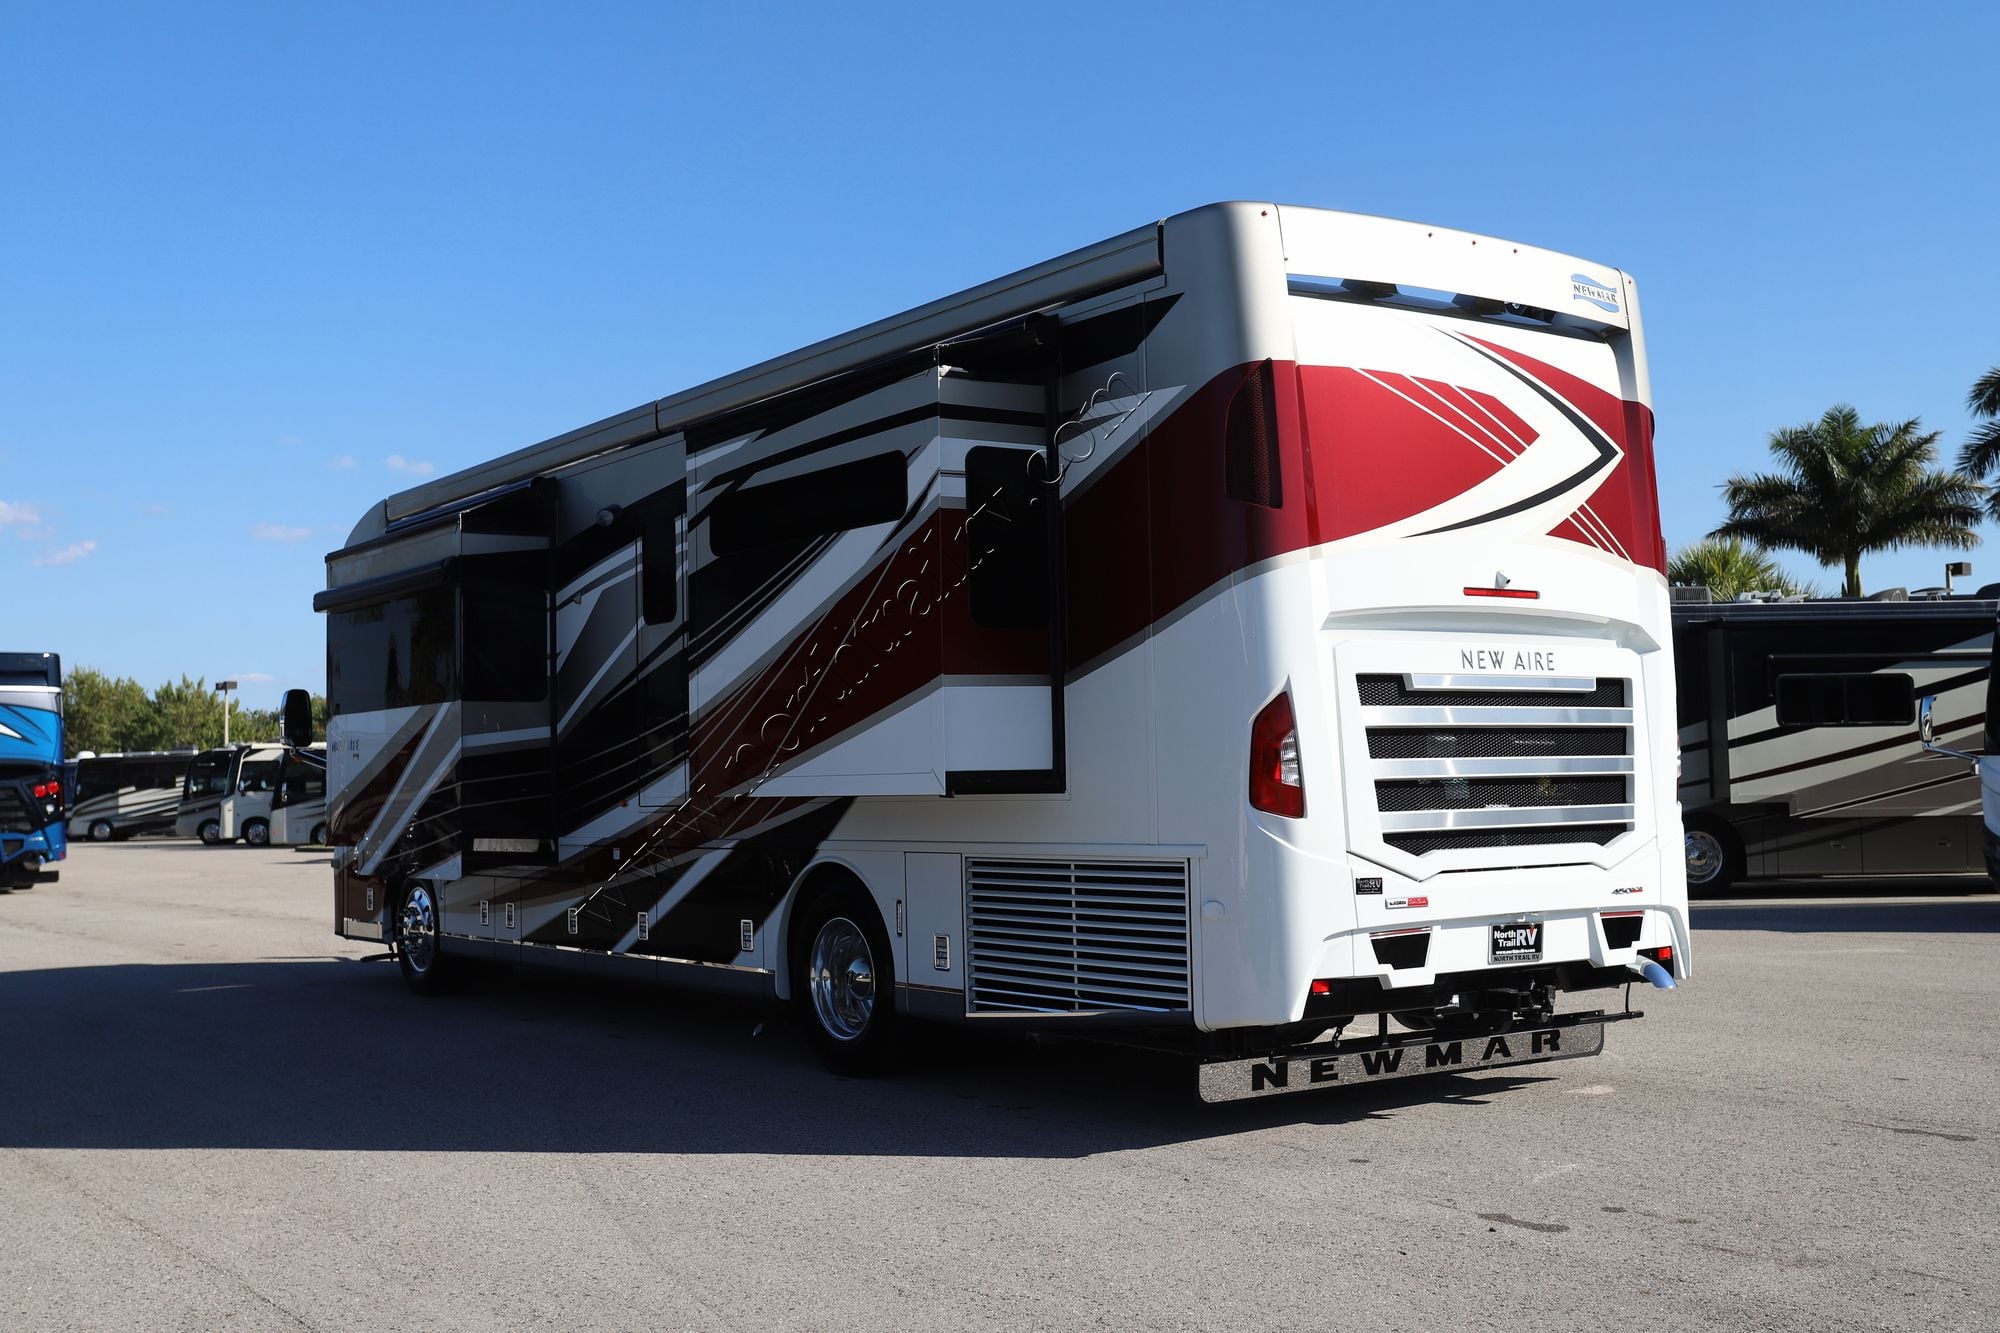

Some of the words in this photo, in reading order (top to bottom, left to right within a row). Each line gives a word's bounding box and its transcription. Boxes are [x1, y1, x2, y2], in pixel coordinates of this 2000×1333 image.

[1461, 649, 1505, 670] NEW
[1514, 651, 1555, 671] AIRE
[1494, 930, 1516, 939] North
[1516, 928, 1538, 947] RV
[1498, 938, 1516, 947] Trail
[1251, 1029, 1561, 1092] NEWMAR
